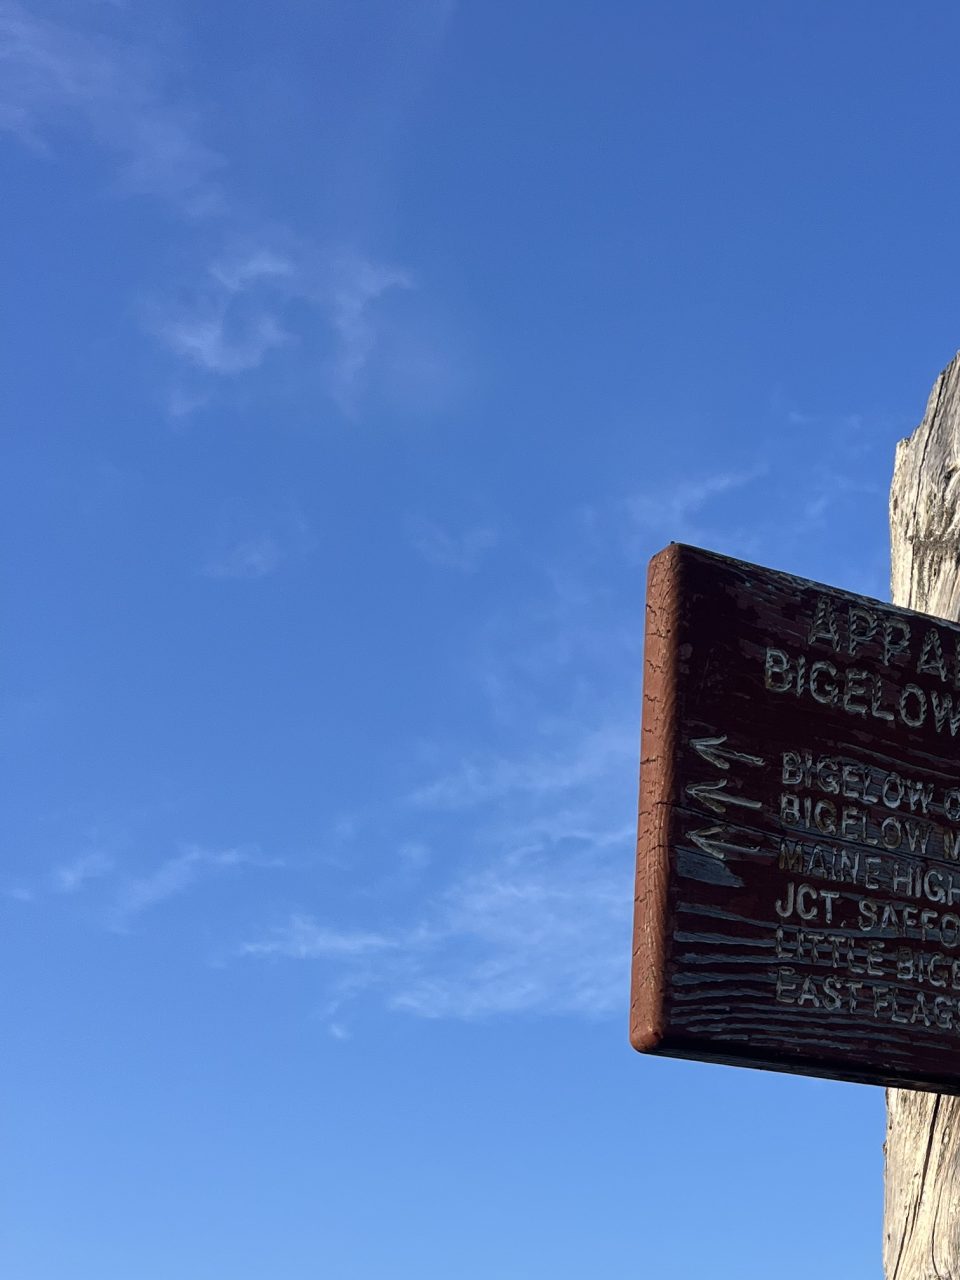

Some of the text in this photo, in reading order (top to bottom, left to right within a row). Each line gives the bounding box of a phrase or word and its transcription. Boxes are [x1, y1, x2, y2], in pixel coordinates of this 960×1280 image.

[782, 752, 935, 814] BIGELOW
[780, 791, 934, 854] BIGELOW
[779, 837, 882, 889] MAINE
[776, 925, 886, 977] LITTLE
[776, 966, 864, 1013] EAST
